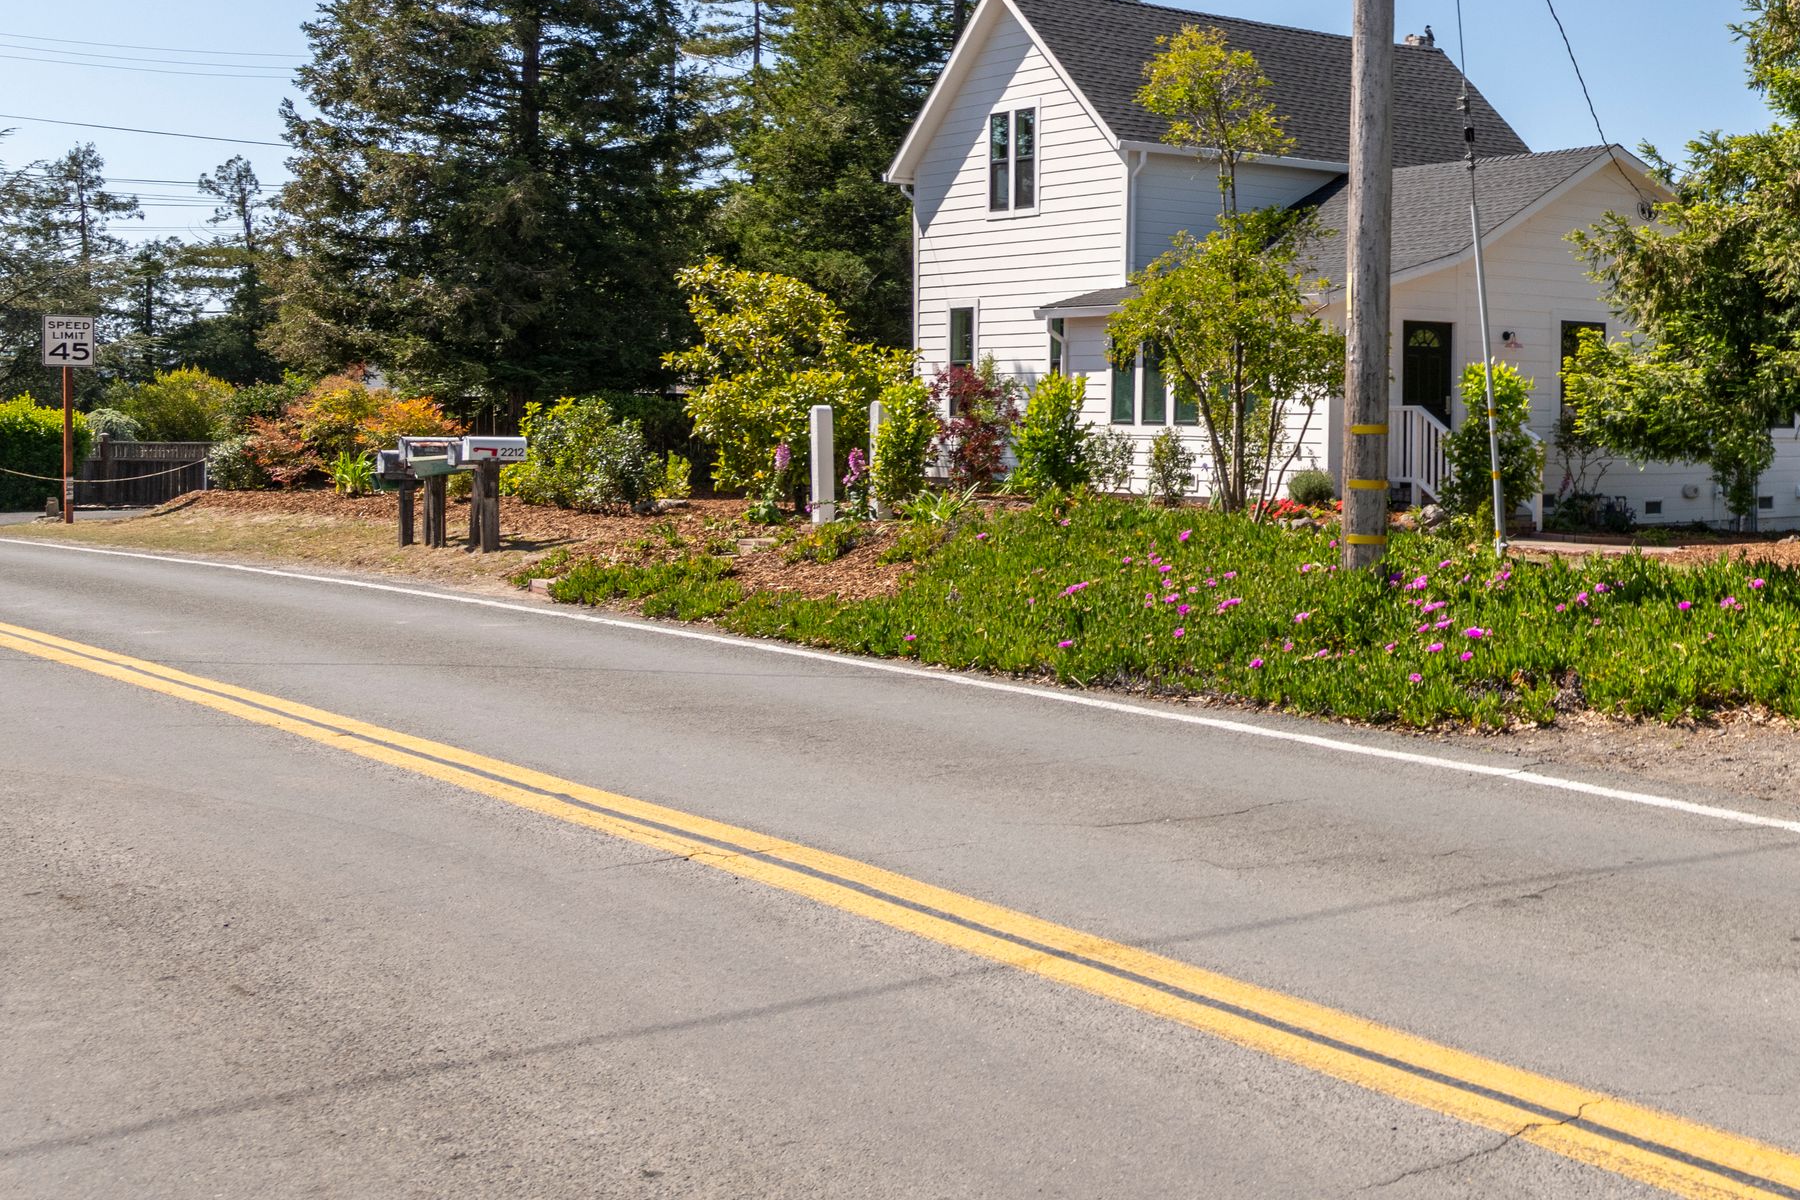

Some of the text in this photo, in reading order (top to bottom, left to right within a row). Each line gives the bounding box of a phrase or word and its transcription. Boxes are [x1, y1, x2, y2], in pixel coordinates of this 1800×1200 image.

[48, 321, 90, 330] SPEED
[52, 332, 85, 340] LIMIT
[48, 342, 90, 361] 45
[501, 447, 524, 457] 2212
